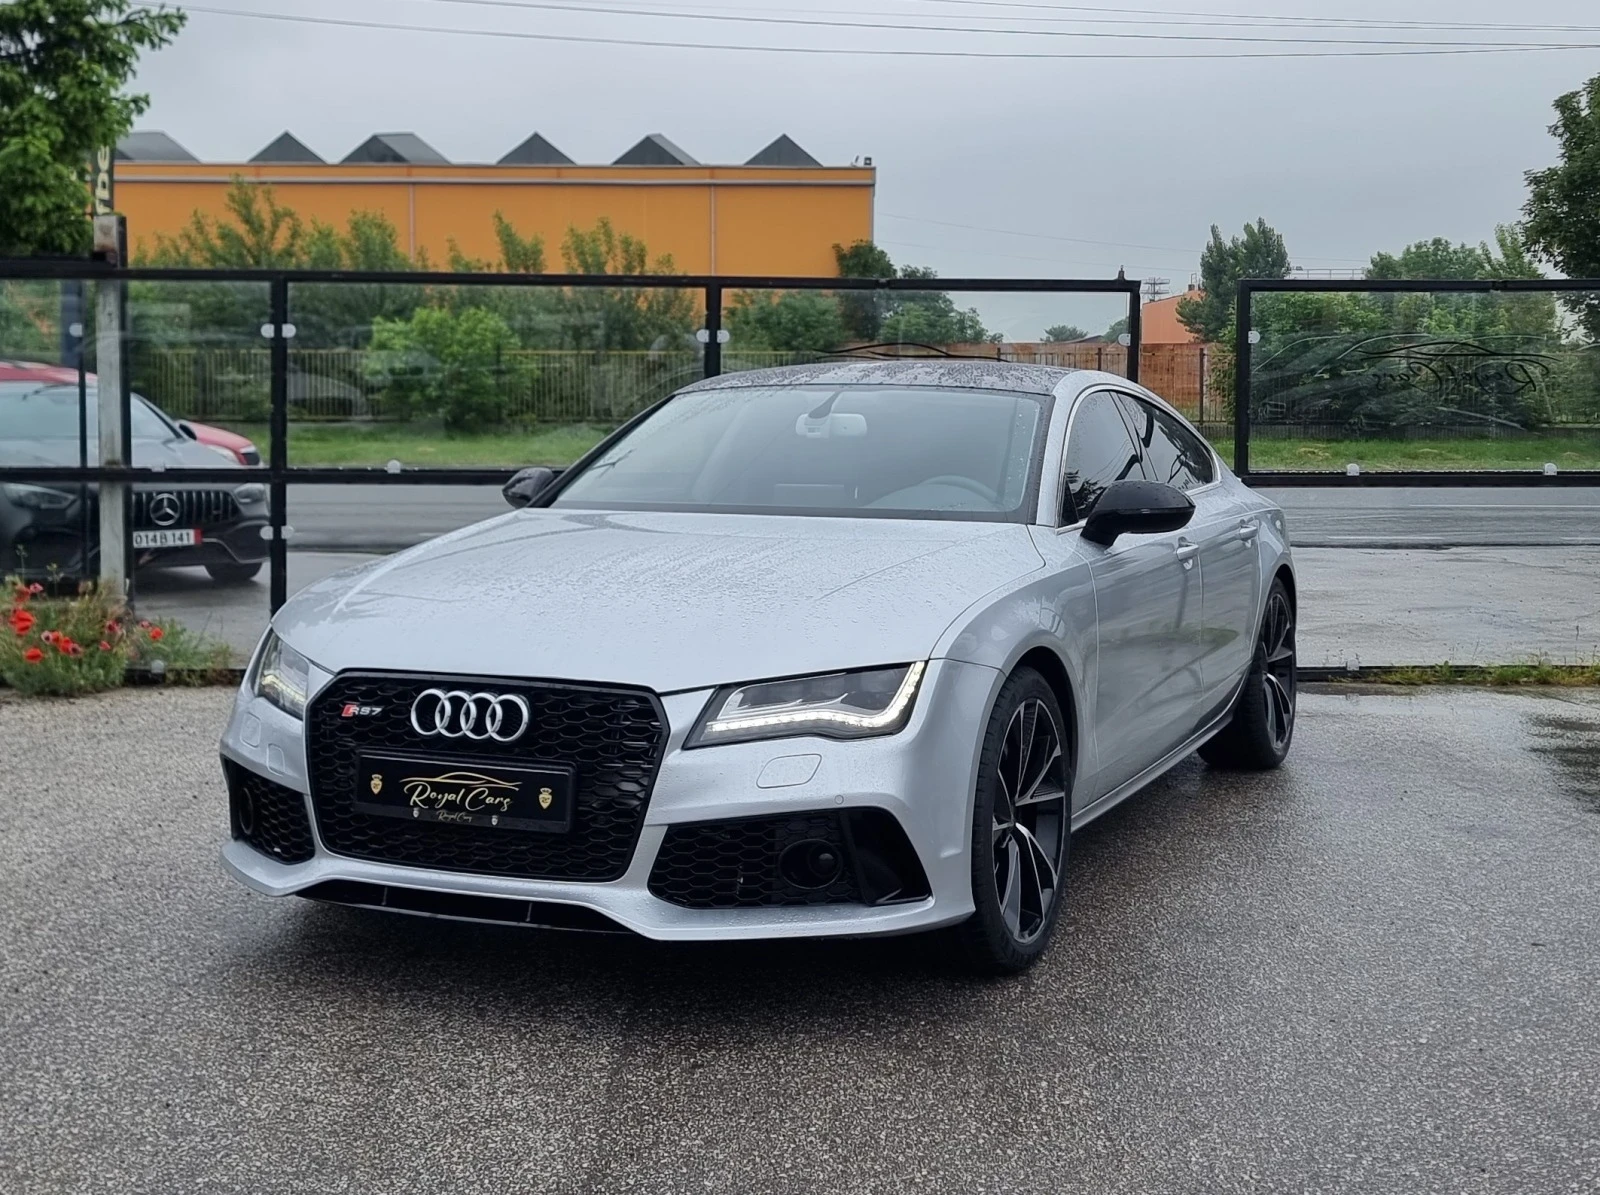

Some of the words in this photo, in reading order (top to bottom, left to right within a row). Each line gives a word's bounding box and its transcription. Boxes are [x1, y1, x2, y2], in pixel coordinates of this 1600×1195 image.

[342, 703, 383, 717] RS7
[404, 781, 466, 809] Royal
[465, 787, 513, 812] Cars
